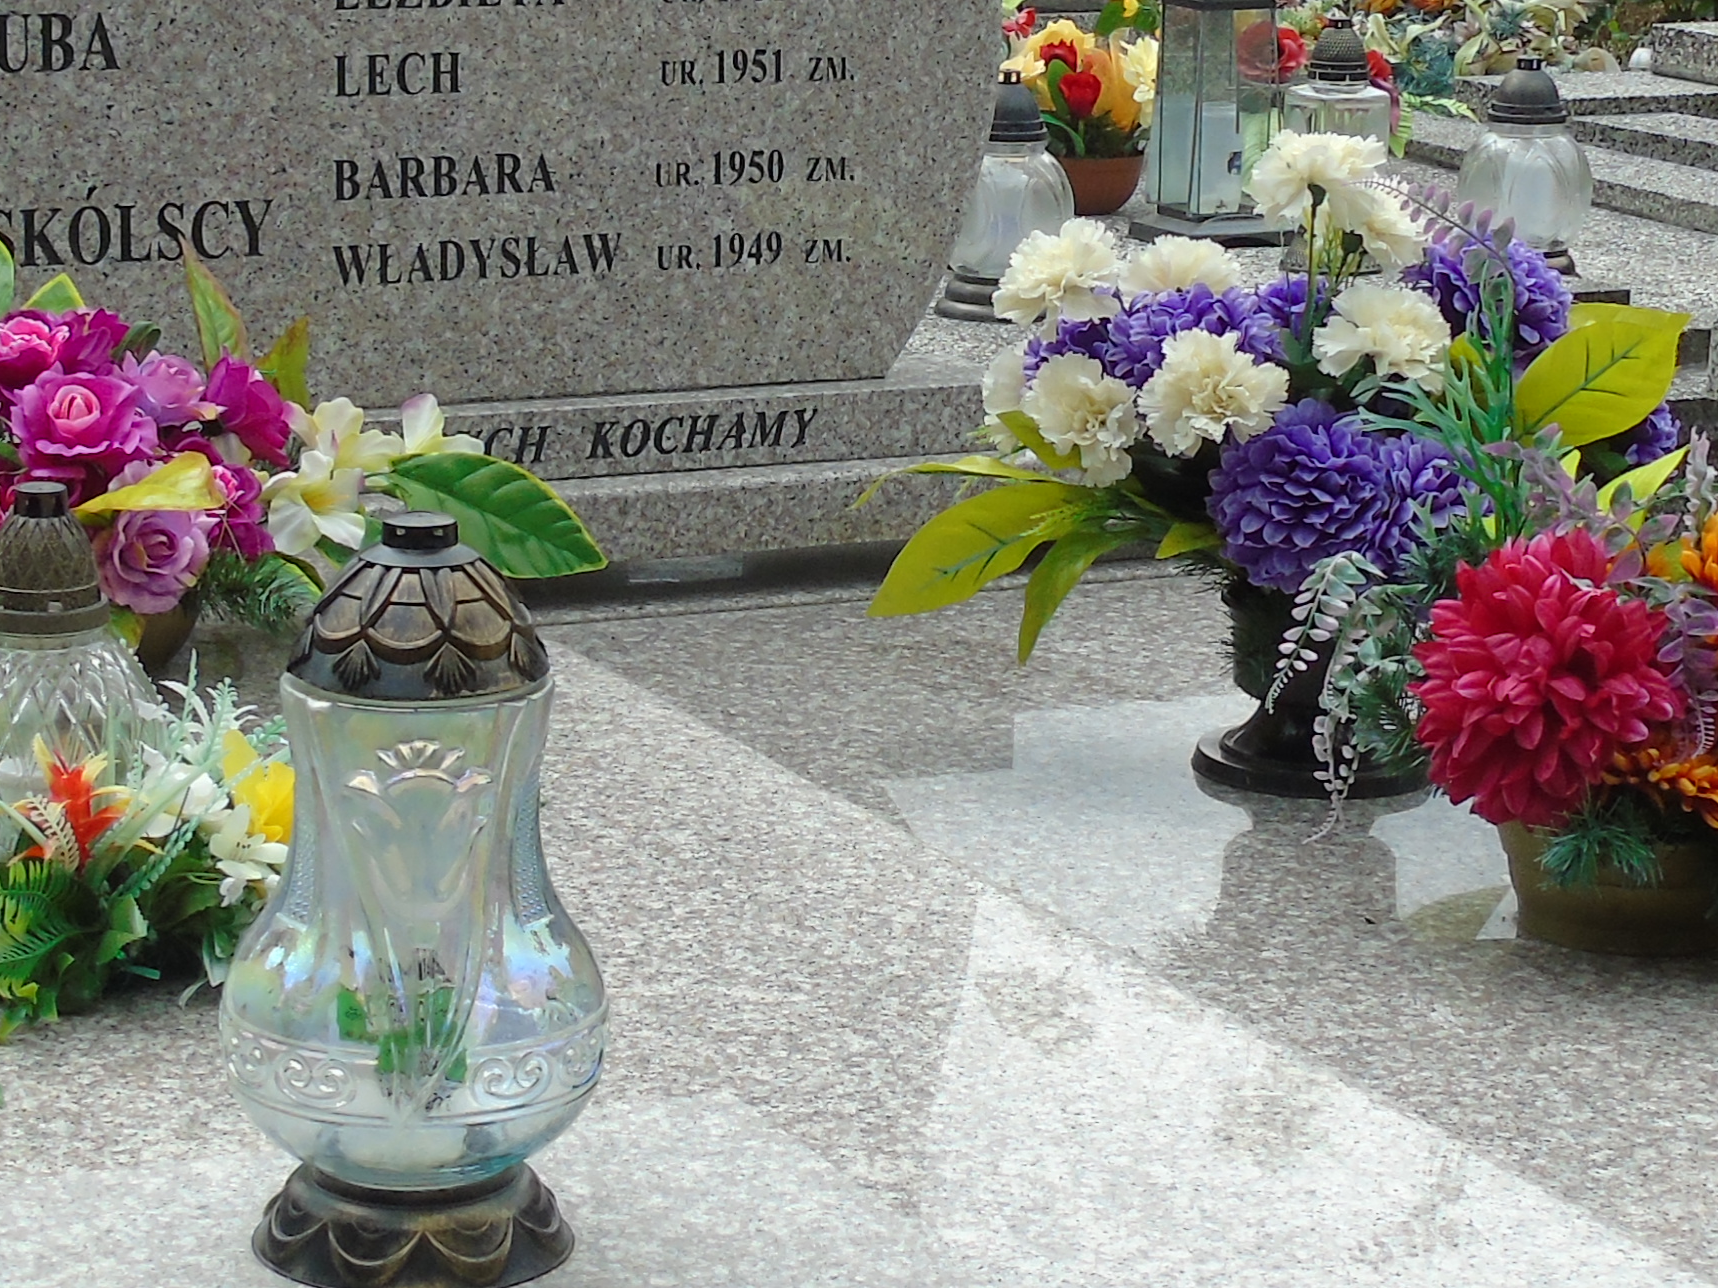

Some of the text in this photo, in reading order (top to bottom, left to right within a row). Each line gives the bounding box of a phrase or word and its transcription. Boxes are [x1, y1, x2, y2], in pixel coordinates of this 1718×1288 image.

[334, 51, 462, 98] LECH
[715, 49, 783, 85] 1951
[808, 56, 855, 82] ZM.
[333, 149, 855, 201] BARBARA UR. 1950 ZM.
[333, 232, 622, 287] WŁADYSŁAW
[713, 231, 783, 269] 1949
[804, 238, 851, 263] ZM.
[586, 408, 819, 460] KOCHAMY
